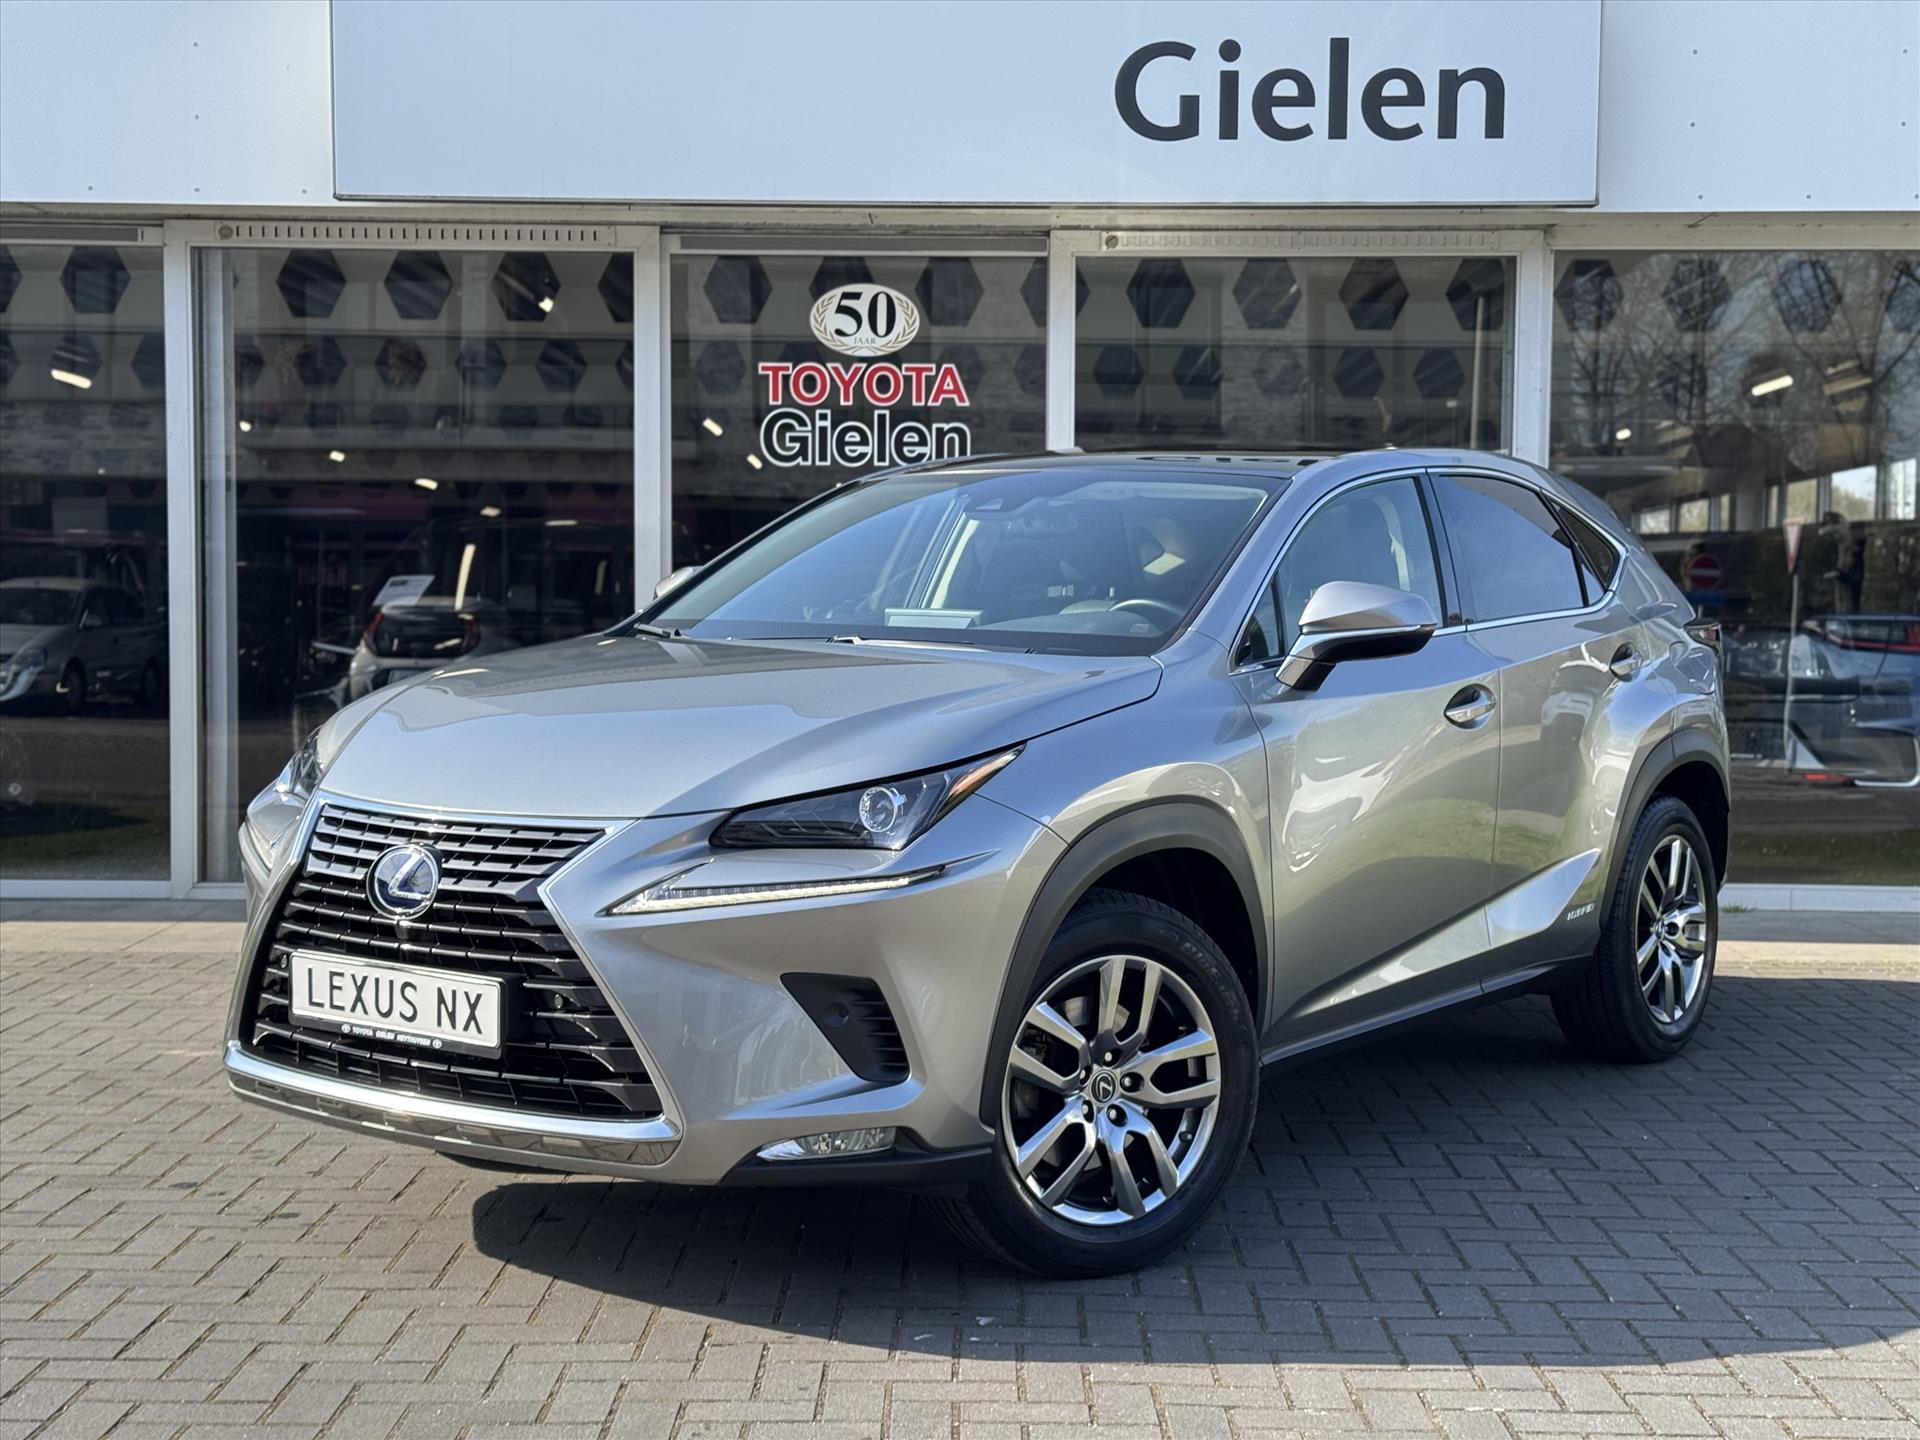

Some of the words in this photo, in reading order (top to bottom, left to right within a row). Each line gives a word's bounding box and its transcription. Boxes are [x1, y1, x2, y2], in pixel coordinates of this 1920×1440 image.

[1114, 37, 1506, 142] Gielen
[834, 291, 897, 338] 50
[853, 337, 876, 345] JAAR
[758, 362, 970, 406] TOYOTA
[760, 408, 971, 467] Gielen
[307, 967, 418, 1023] LEXUS
[436, 986, 483, 1035] NX
[352, 1026, 374, 1037] TOYOTA
